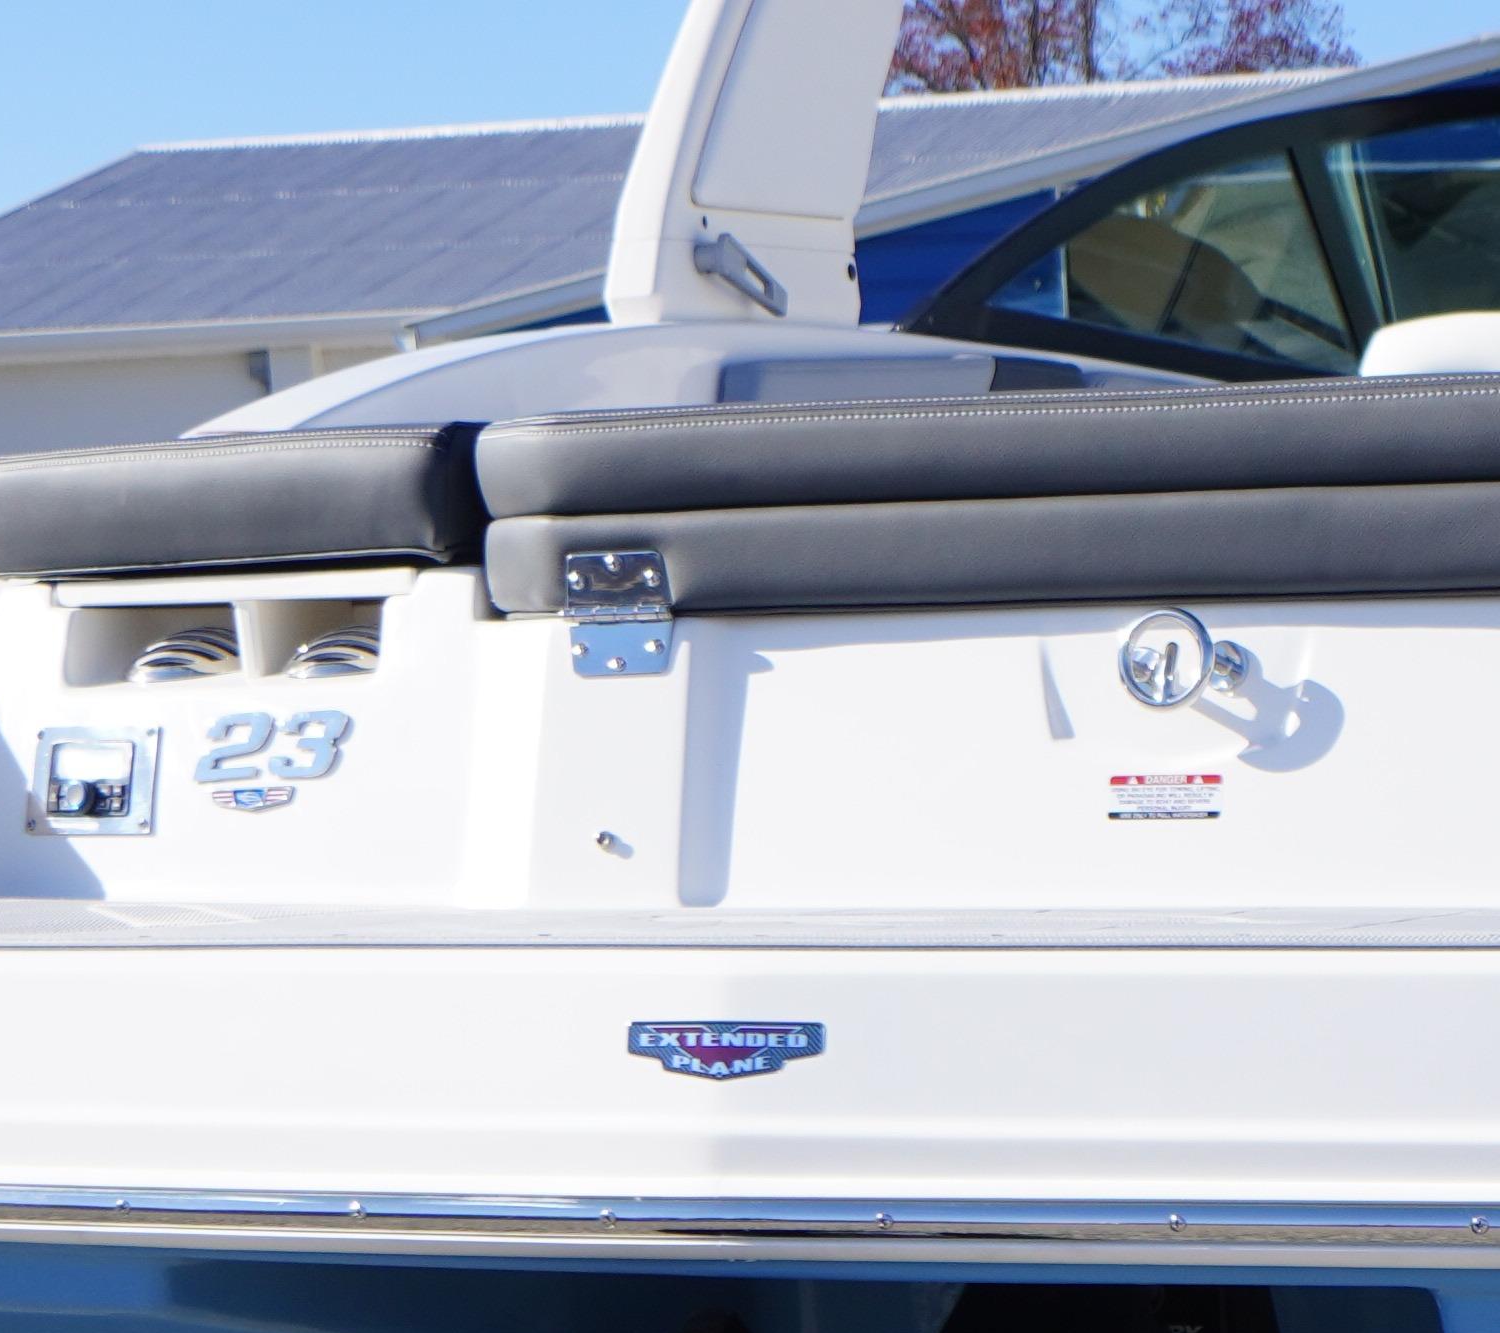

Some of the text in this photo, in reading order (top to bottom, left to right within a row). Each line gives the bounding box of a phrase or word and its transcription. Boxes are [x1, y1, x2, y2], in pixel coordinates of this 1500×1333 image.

[194, 710, 350, 783] 23
[1146, 775, 1187, 784] DANGER
[639, 1033, 808, 1048] EXTENDED
[672, 1055, 771, 1077] PLANE
